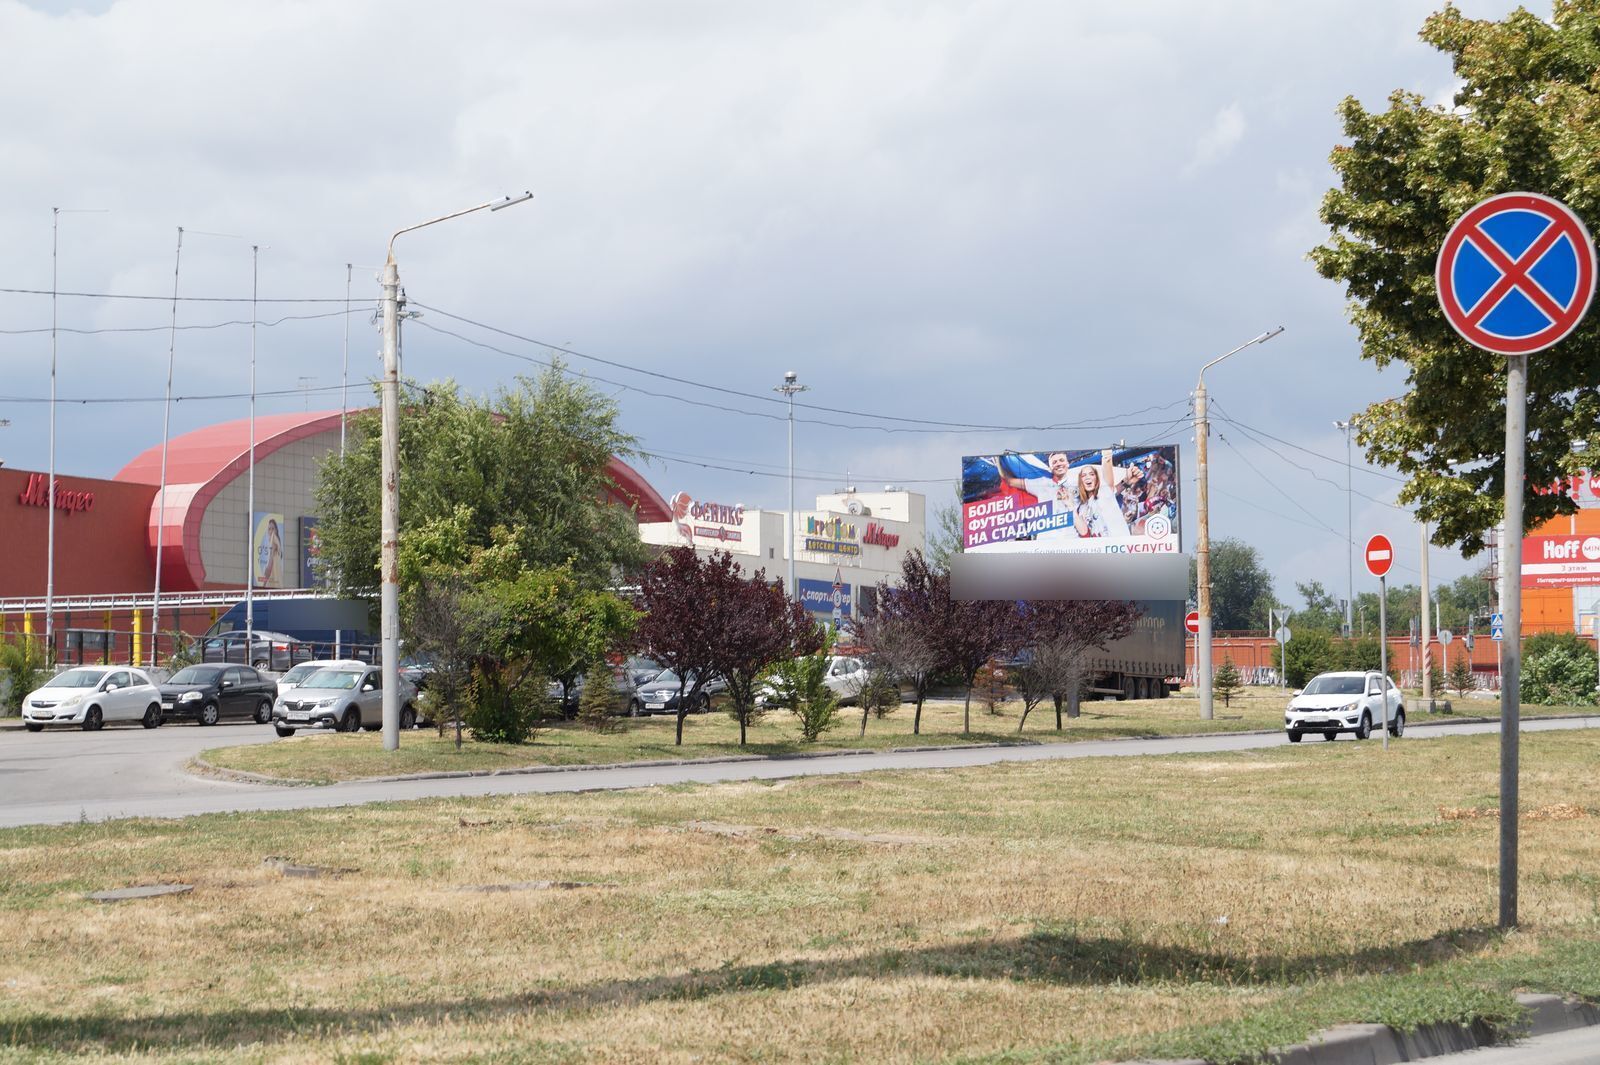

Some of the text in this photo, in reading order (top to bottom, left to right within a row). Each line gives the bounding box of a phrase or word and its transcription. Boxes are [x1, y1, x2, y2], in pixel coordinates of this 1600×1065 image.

[968, 496, 1014, 519] БОЛЕЙ
[968, 504, 1048, 532] ФУТБОЛОМ
[968, 513, 1069, 546] НА СТАДИОНЕ!
[1105, 543, 1173, 554] госуслуги
[806, 589, 851, 606] спортмер
